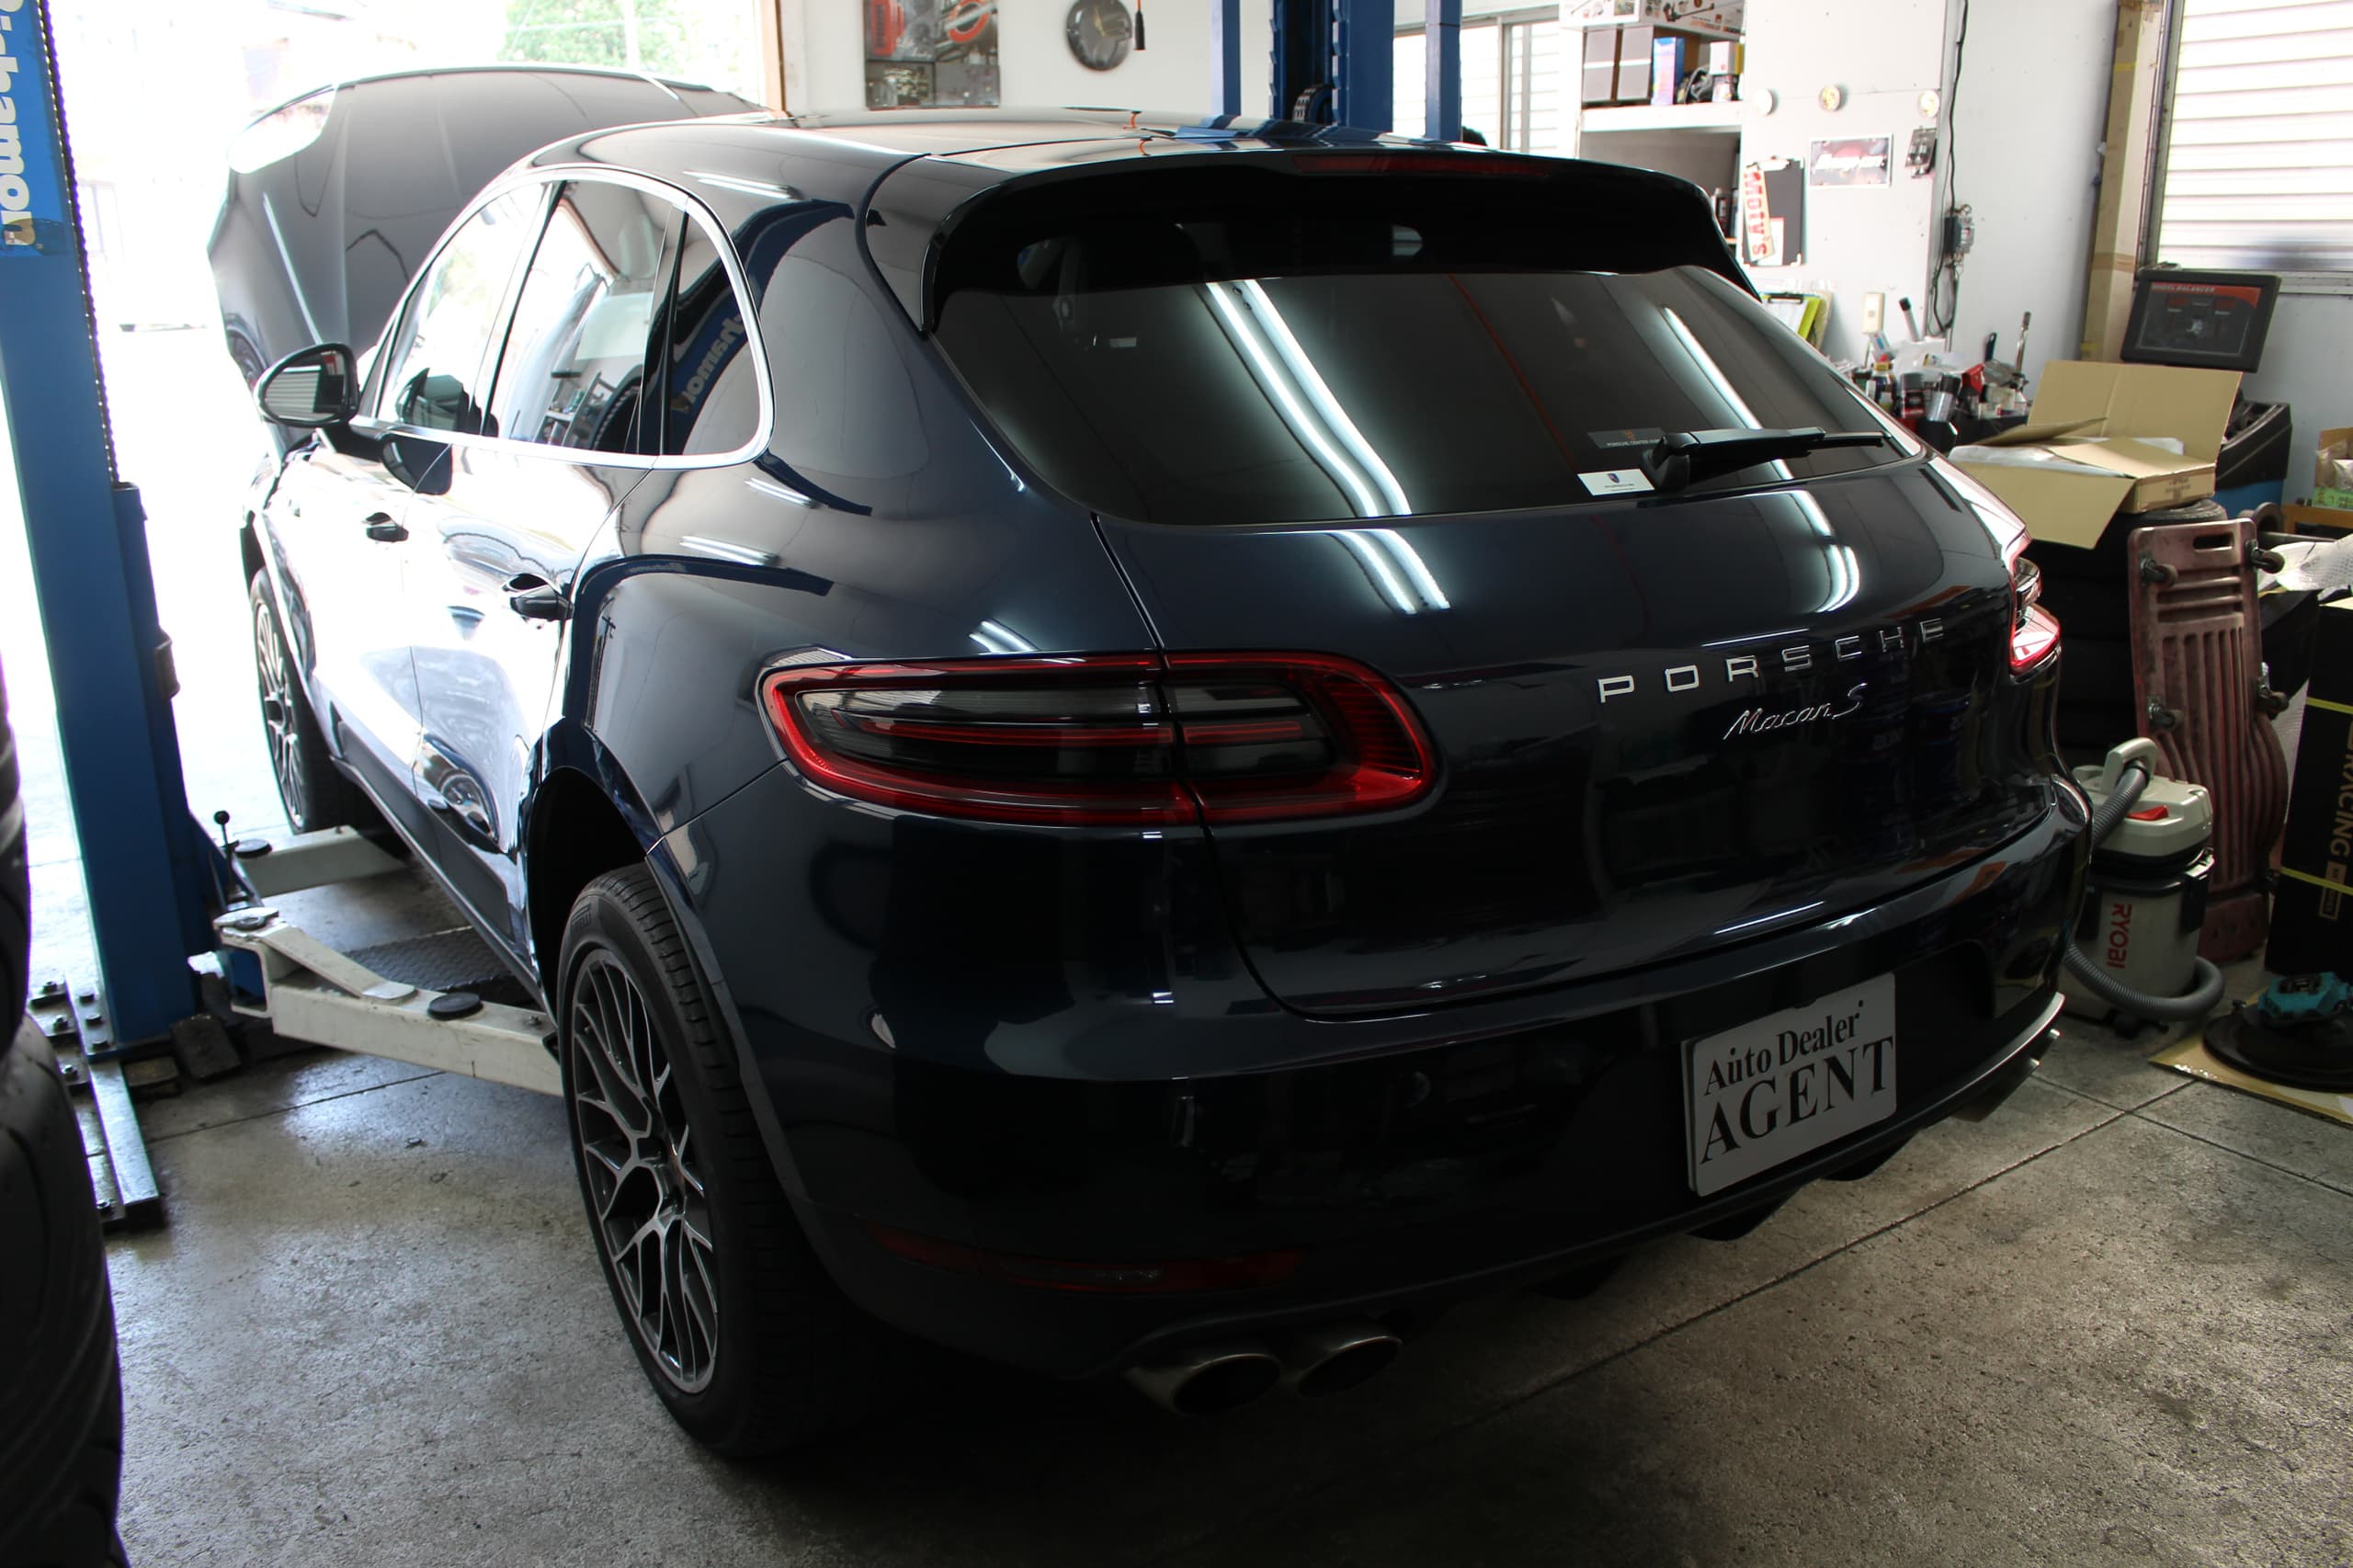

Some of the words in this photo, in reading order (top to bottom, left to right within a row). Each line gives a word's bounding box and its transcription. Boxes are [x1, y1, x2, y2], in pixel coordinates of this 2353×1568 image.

[1597, 617, 1944, 704] PORSCHE
[1722, 702, 1832, 740] Macan
[1832, 682, 1869, 720] S
[2106, 903, 2132, 969] RYOBI
[1703, 1046, 1772, 1096] Auto
[1776, 1012, 1860, 1066] Dealer
[1699, 1036, 1894, 1165] AGENT
